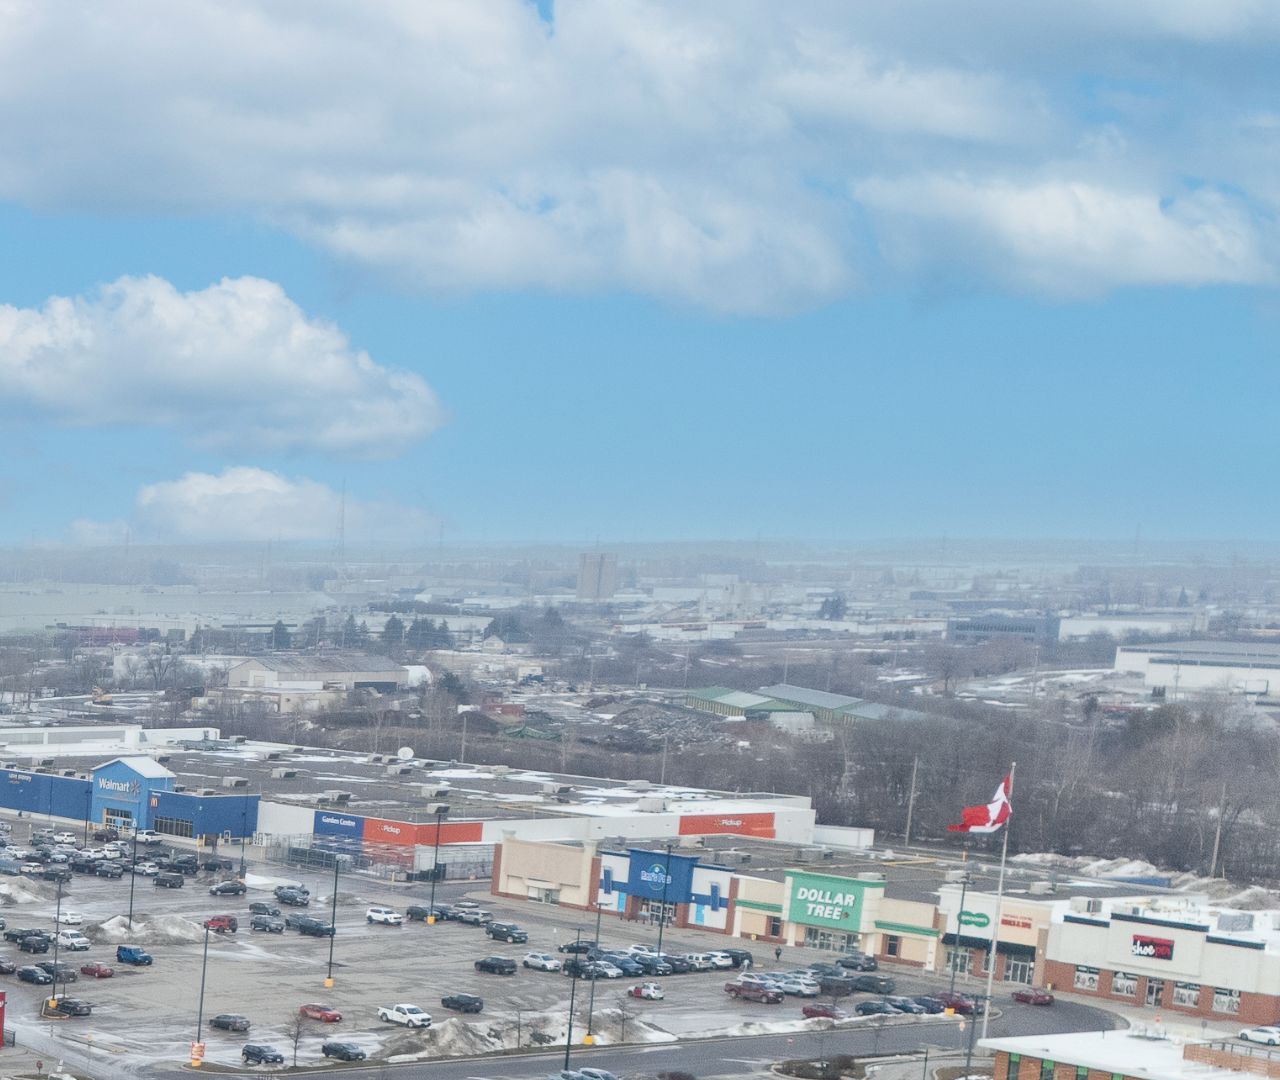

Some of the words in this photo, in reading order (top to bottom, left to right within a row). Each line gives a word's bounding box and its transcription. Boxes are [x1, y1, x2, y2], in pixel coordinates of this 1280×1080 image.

[98, 778, 130, 792] Walmart
[322, 816, 339, 825] Garden
[340, 819, 356, 827] Centre
[797, 887, 855, 907] DOLLAR
[805, 903, 842, 920] TREE
